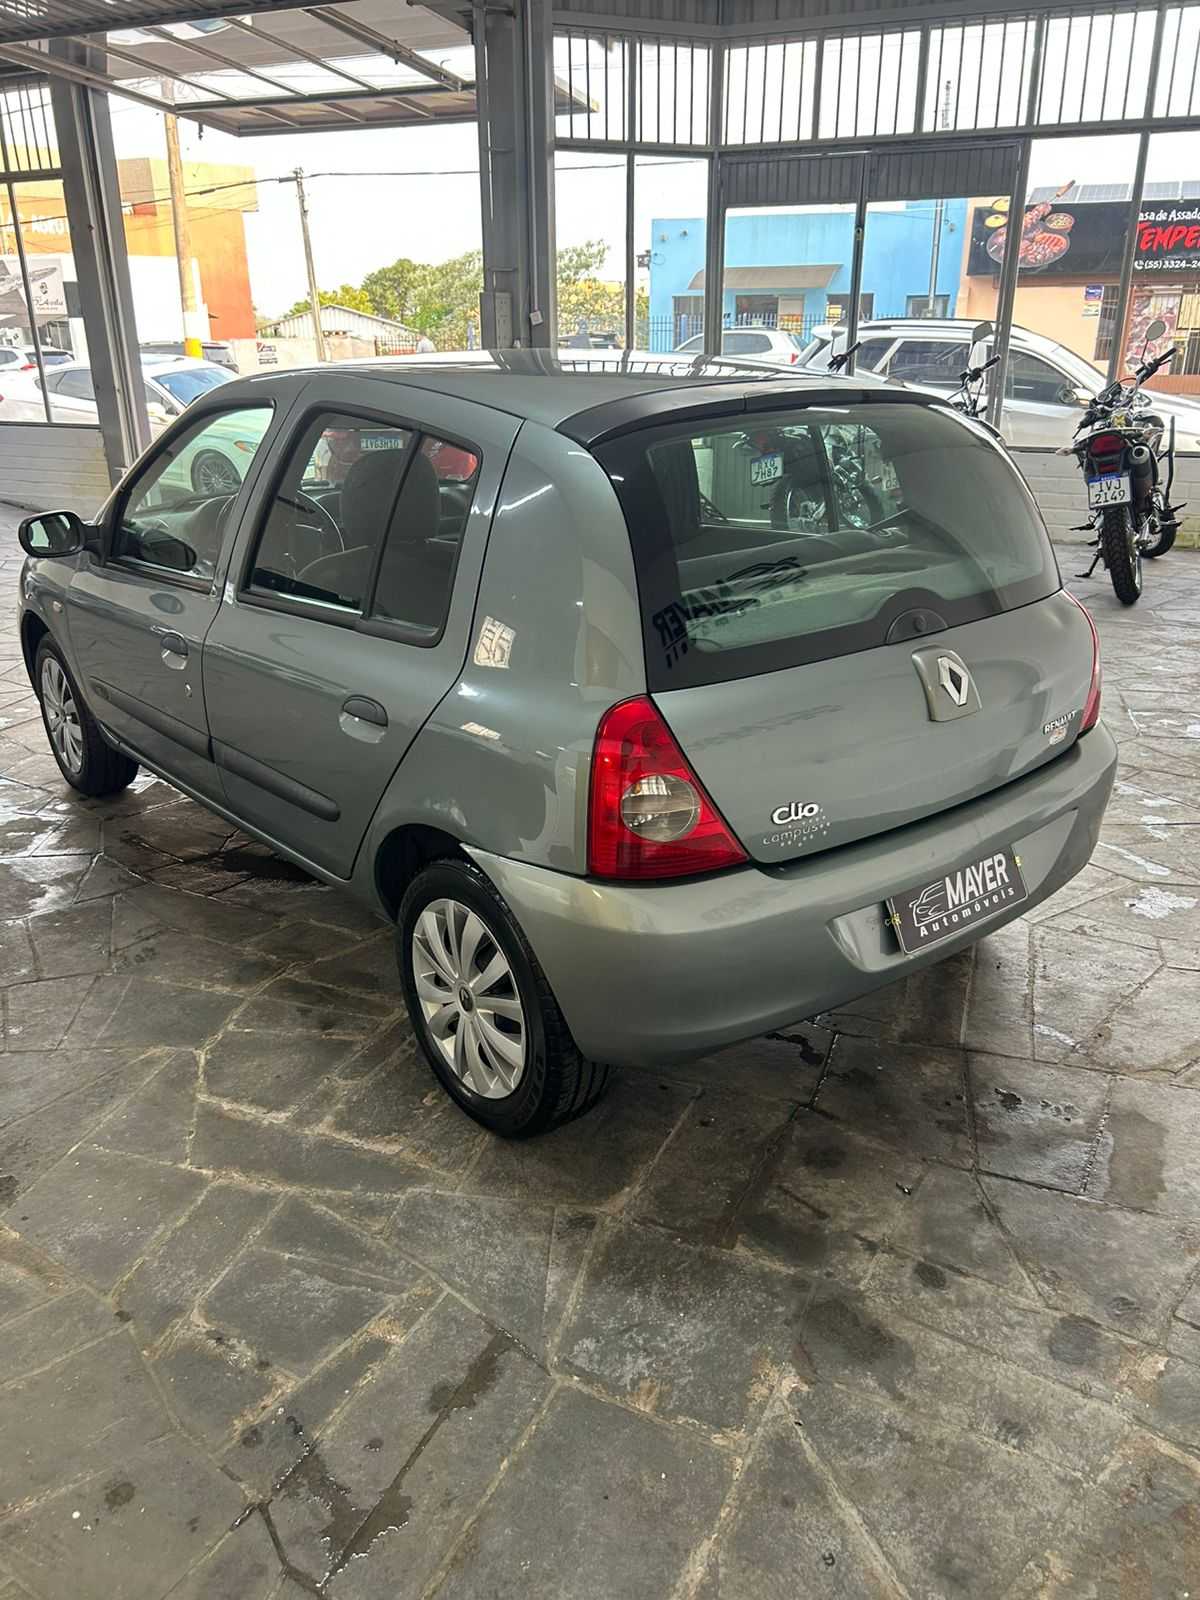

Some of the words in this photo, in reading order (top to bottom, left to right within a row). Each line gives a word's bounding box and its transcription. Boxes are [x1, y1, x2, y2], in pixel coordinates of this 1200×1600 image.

[1137, 221, 1200, 253] TEMPE
[1144, 260, 1162, 270] (55)
[1095, 489, 1126, 504] 2149
[1099, 479, 1121, 492] IVJ
[945, 853, 1010, 910] MAYER
[920, 886, 1016, 938] Automóveis
